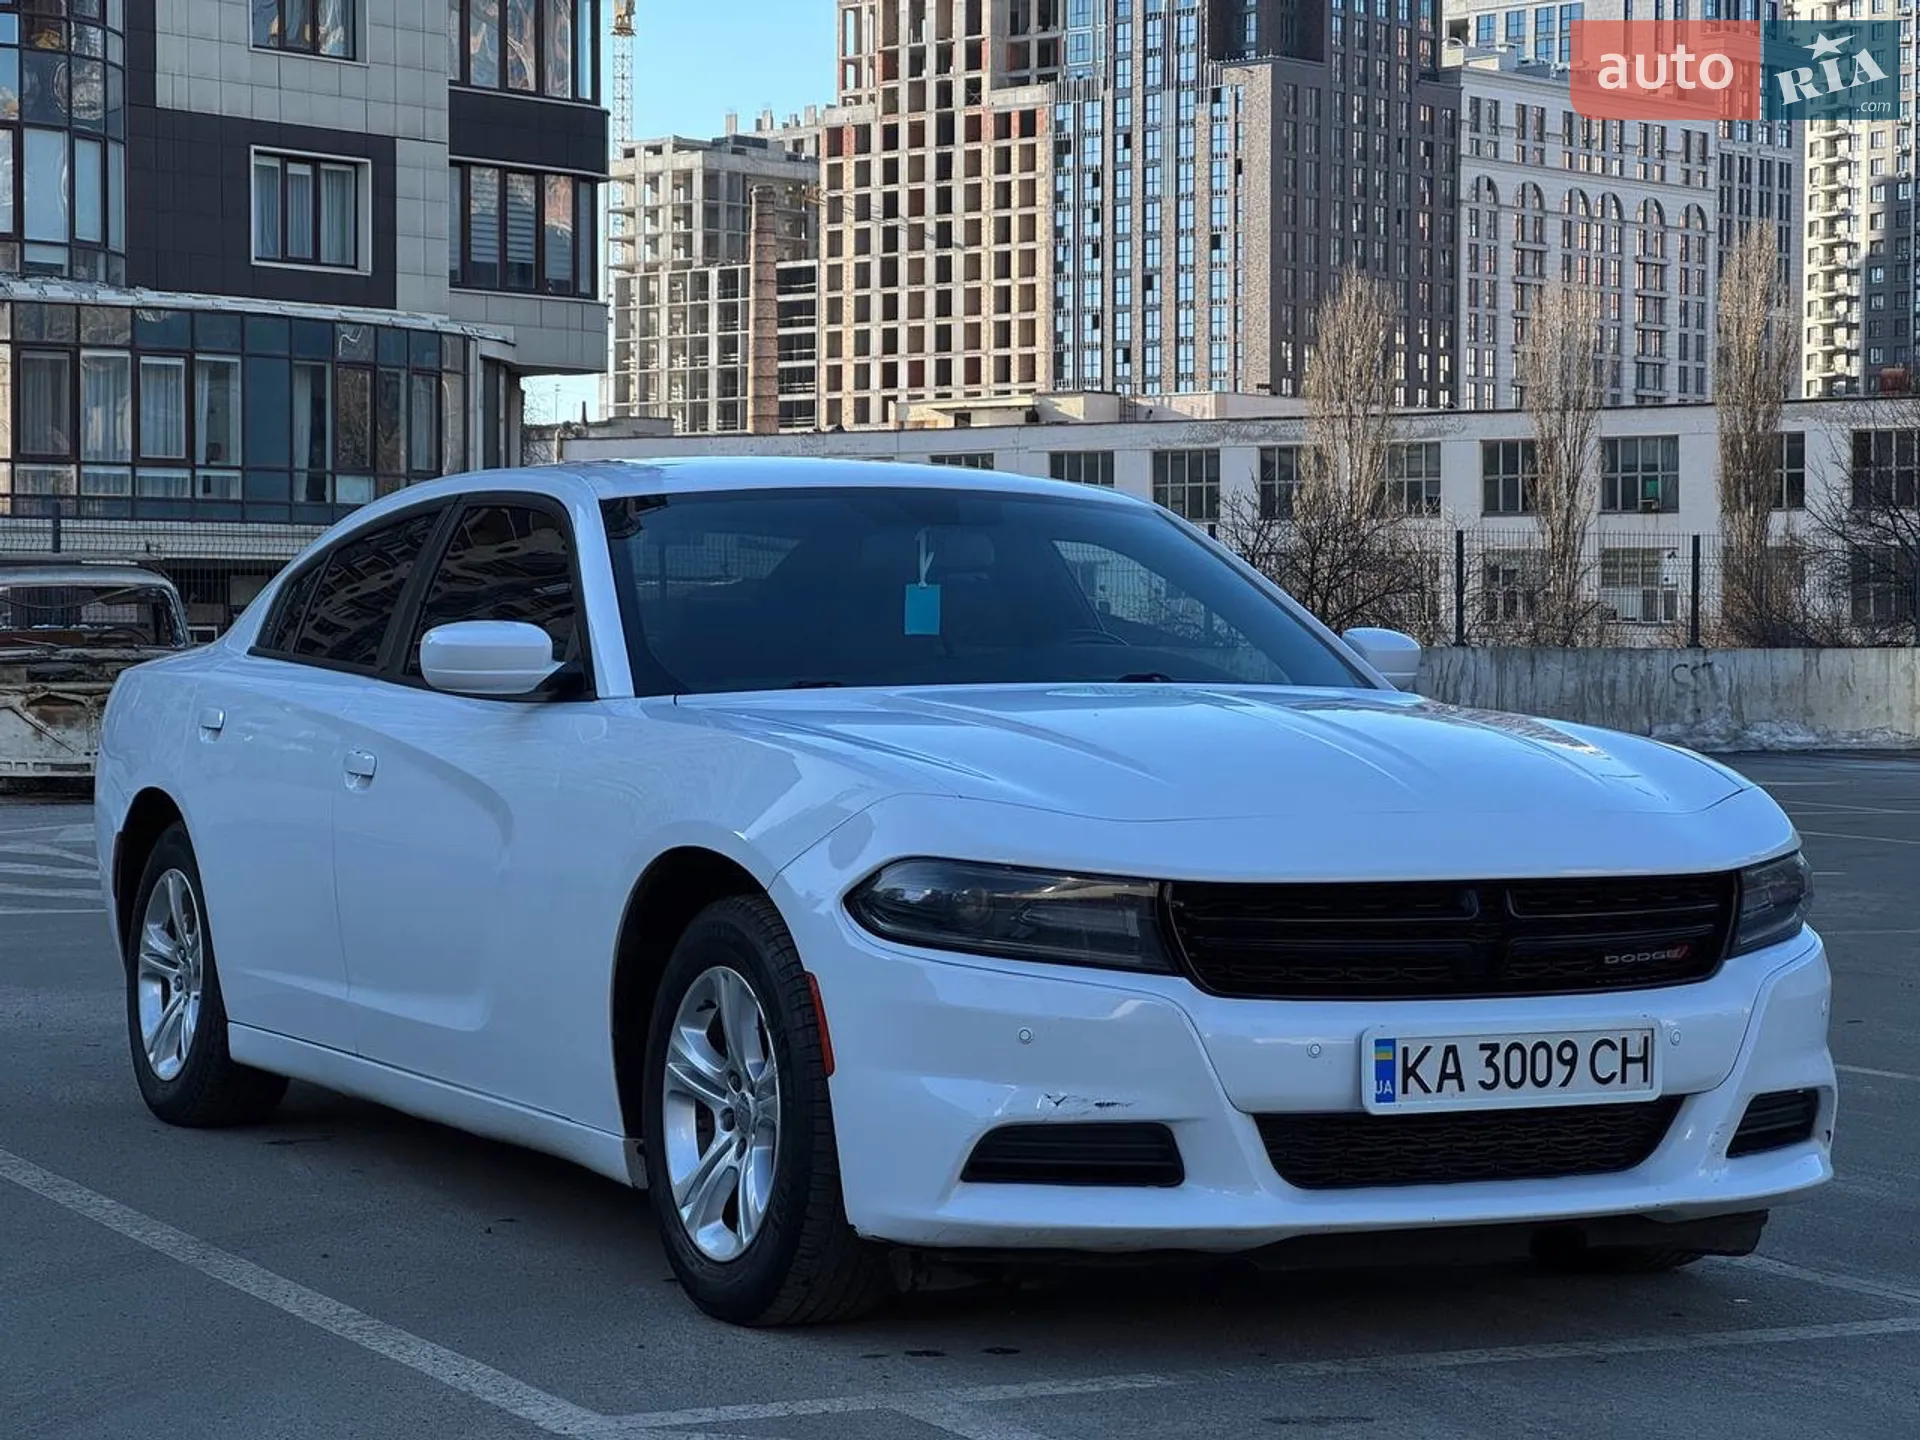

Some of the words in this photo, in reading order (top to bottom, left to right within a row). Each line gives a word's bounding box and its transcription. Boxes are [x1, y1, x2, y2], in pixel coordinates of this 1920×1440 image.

[1604, 949, 1679, 964] DODGE
[1401, 1045, 1465, 1094] KA
[1477, 1039, 1579, 1091] 3009
[1589, 1036, 1650, 1085] CH
[1374, 1080, 1393, 1095] UA
